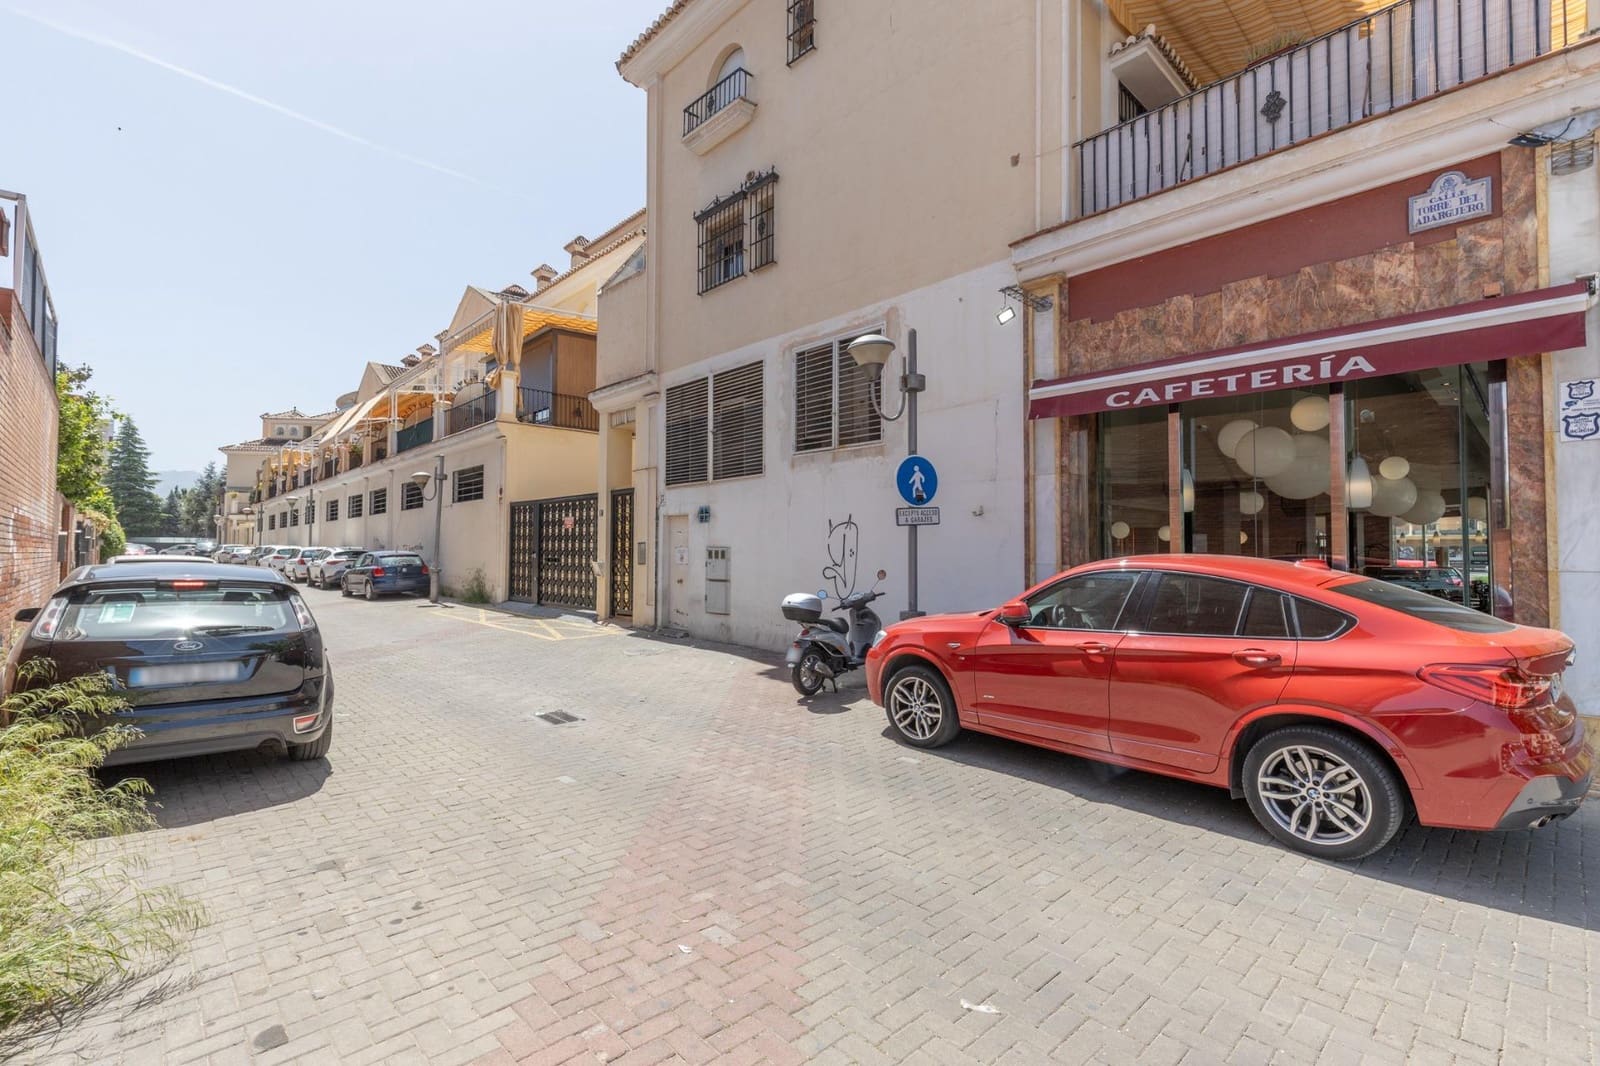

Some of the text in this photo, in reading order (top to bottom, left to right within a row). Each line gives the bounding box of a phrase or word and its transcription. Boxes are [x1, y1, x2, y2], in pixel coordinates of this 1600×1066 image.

[1417, 193, 1479, 216] TORRE DEL
[1429, 190, 1466, 203] CALLE
[1105, 354, 1377, 407] CAFETERÍA
